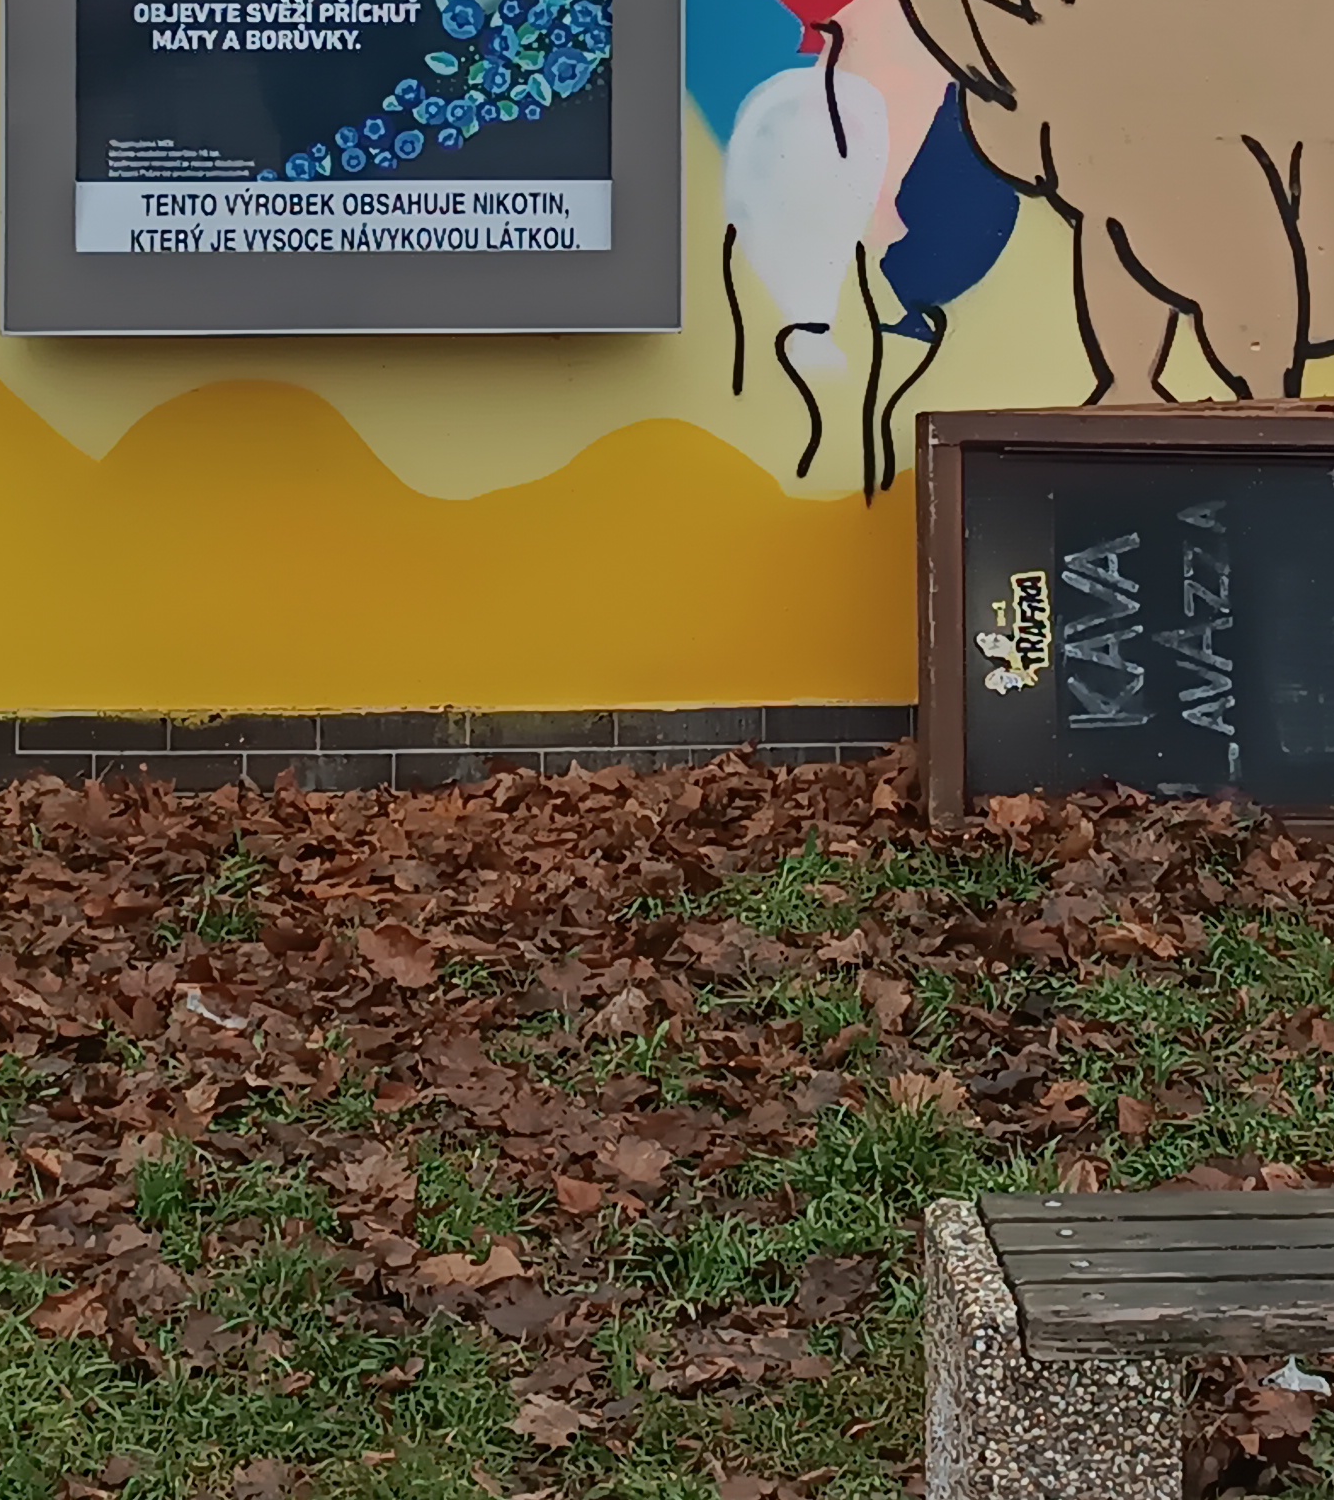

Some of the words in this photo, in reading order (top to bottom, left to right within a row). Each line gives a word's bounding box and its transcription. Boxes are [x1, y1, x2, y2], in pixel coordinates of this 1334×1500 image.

[134, 3, 241, 23] OBJEVTE
[152, 24, 218, 50] MÁTY
[222, 30, 241, 50] A
[246, 24, 362, 50] BORŮVKY.
[141, 193, 217, 217] TENTO
[225, 188, 334, 217] VÝROBEK
[342, 192, 466, 217] OBSAHUJE
[472, 192, 570, 220] NIKOTIN,
[130, 224, 203, 252] KTERÝ
[211, 229, 236, 252] JE
[244, 228, 333, 251] VYSOCE
[341, 224, 479, 250] NÁVYKOVOU
[485, 225, 581, 250] LÁTKOU.
